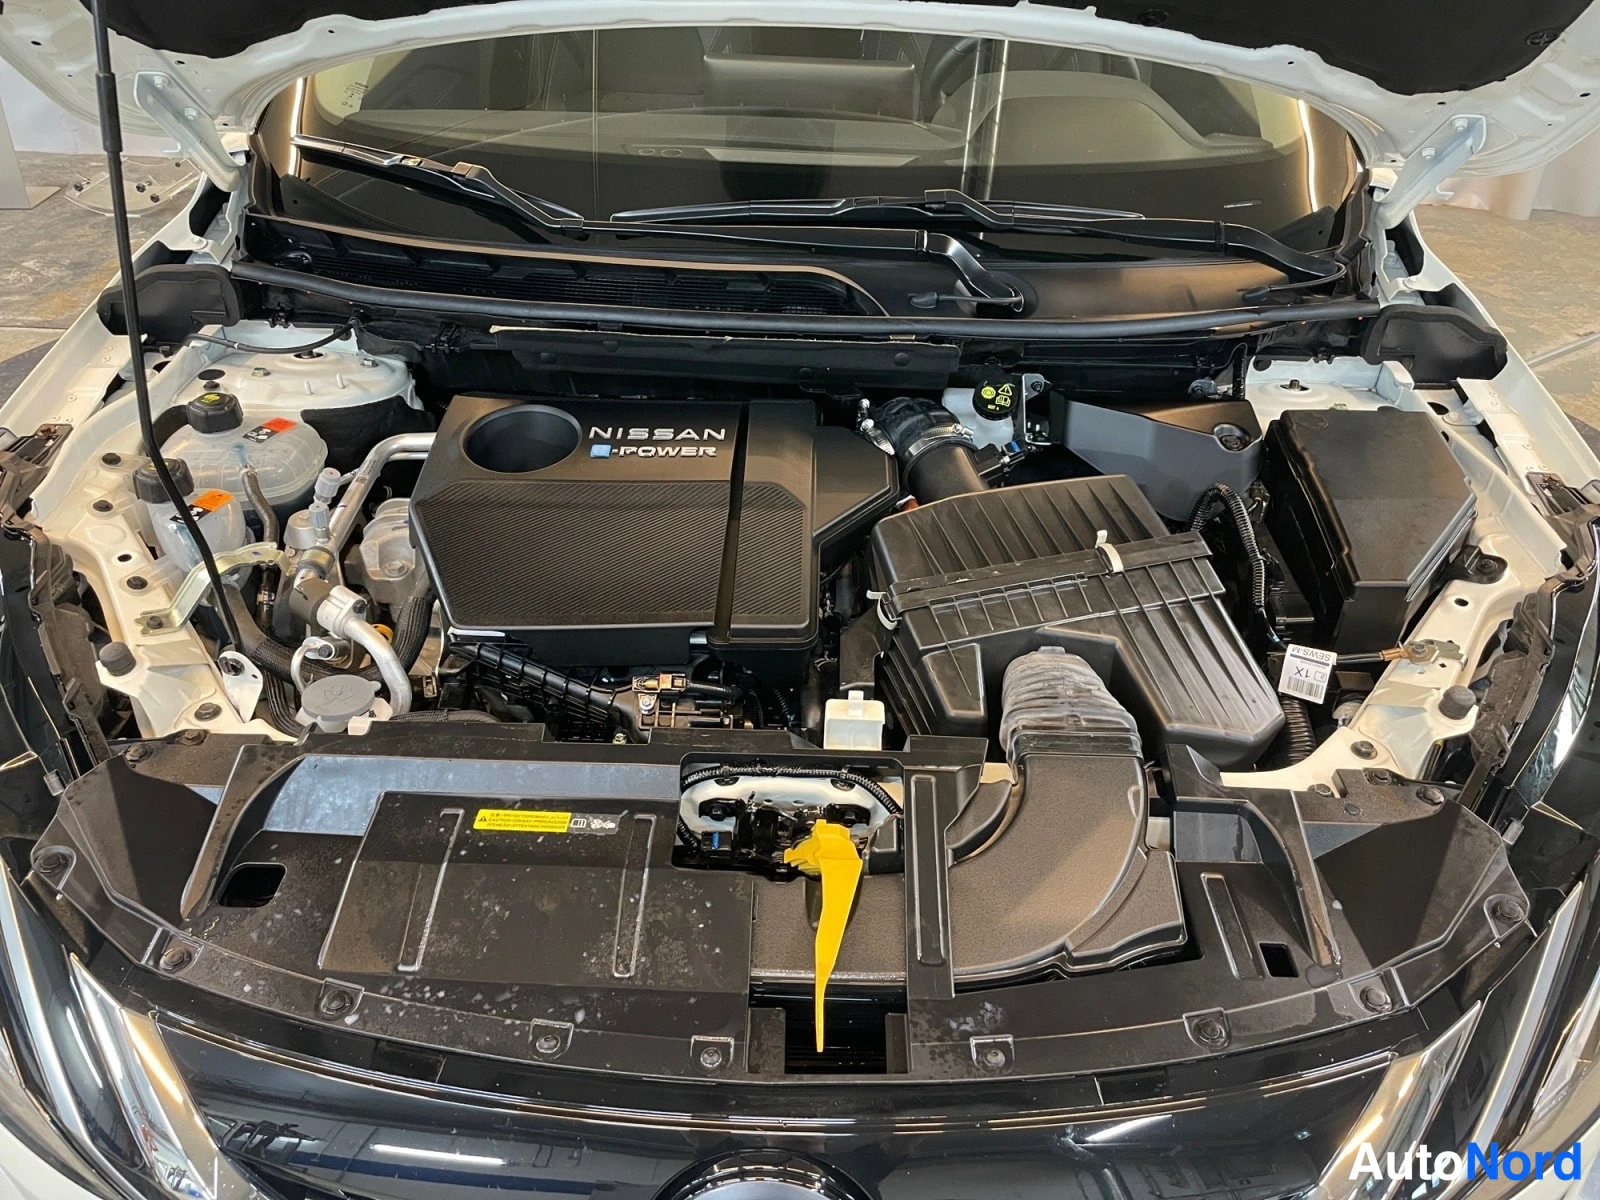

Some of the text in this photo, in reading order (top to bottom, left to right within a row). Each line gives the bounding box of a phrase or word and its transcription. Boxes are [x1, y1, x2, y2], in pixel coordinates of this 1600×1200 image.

[588, 426, 726, 441] NISSAN
[590, 444, 717, 458] -POWER
[1291, 646, 1331, 661] SEWS-M
[1294, 665, 1310, 678] 1X
